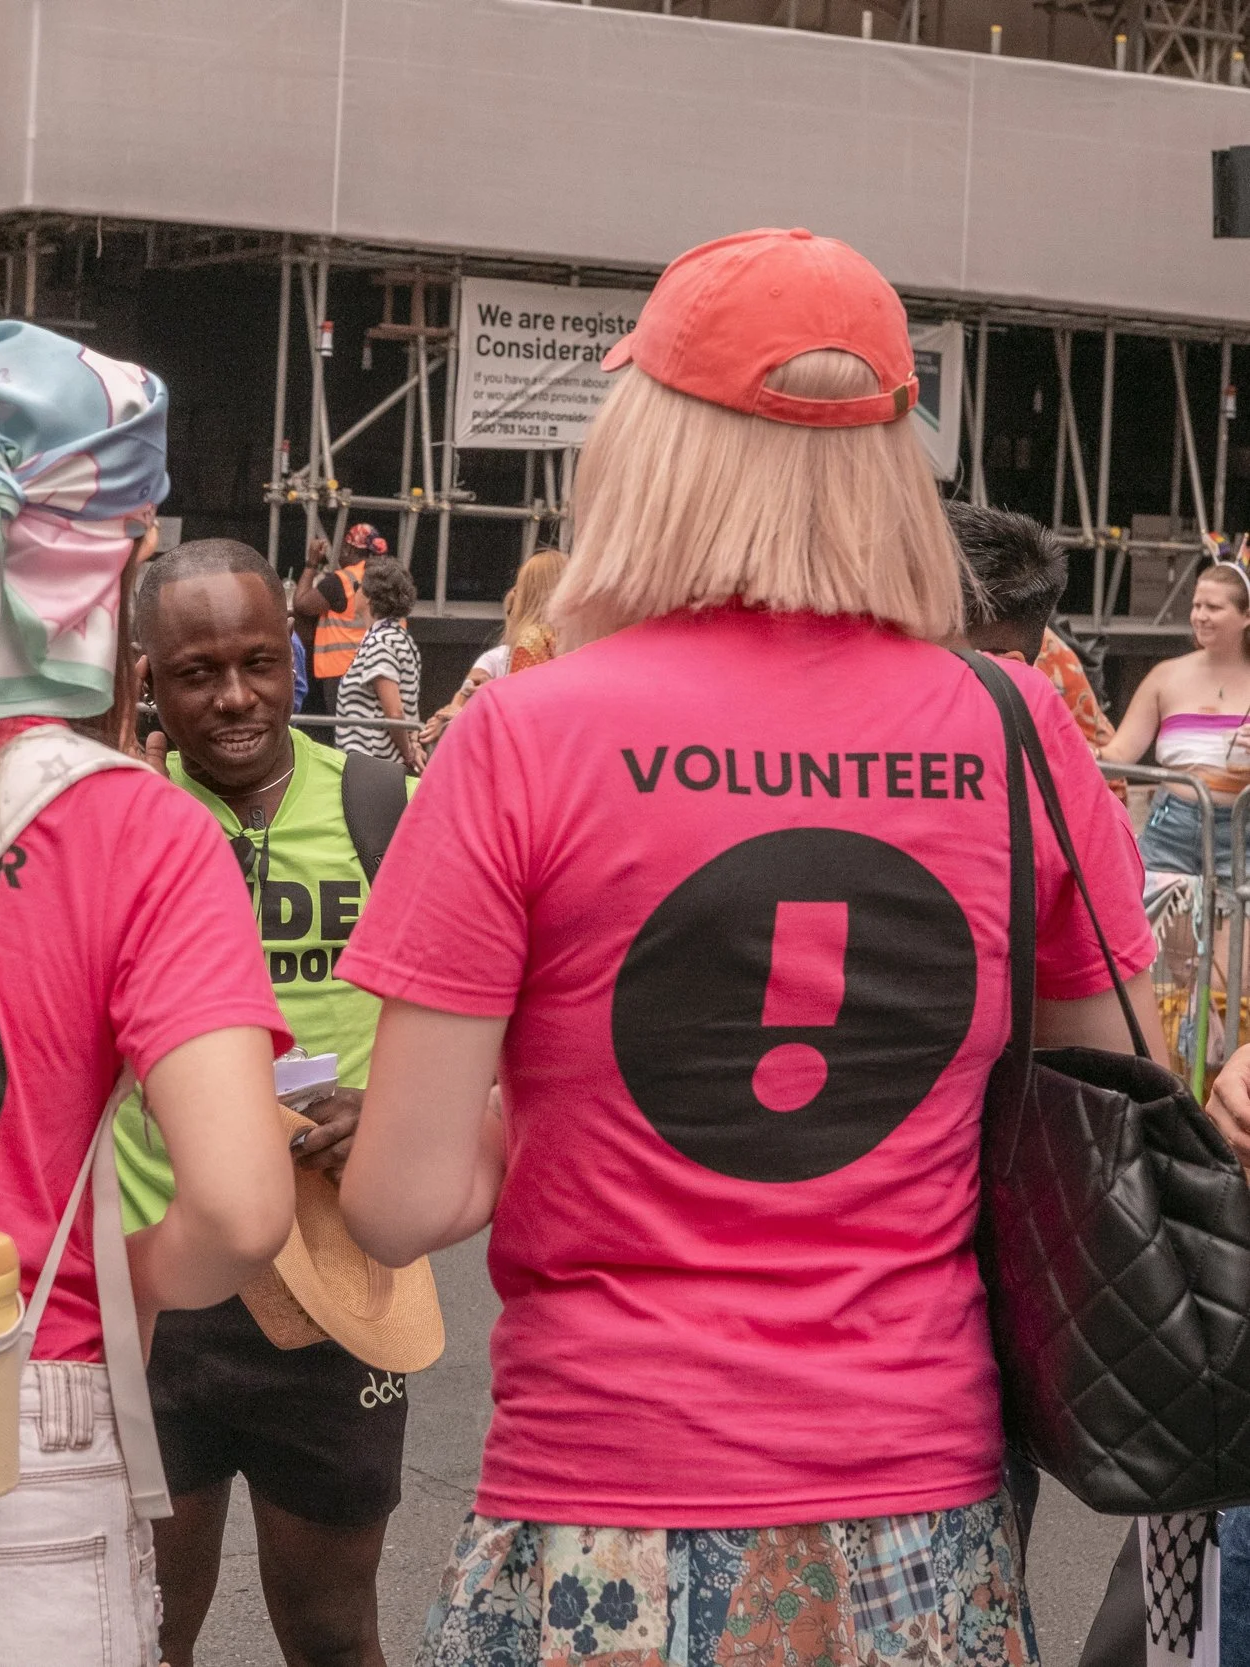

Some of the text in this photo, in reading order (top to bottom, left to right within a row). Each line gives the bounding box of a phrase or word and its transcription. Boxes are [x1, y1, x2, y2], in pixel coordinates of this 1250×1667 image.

[478, 303, 512, 328] We
[518, 312, 555, 331] are
[474, 371, 482, 381] If
[483, 375, 502, 386] you
[474, 390, 484, 399] or
[517, 424, 540, 436] 1423
[621, 744, 985, 800] VOLUNTEER
[247, 880, 362, 941] DE
